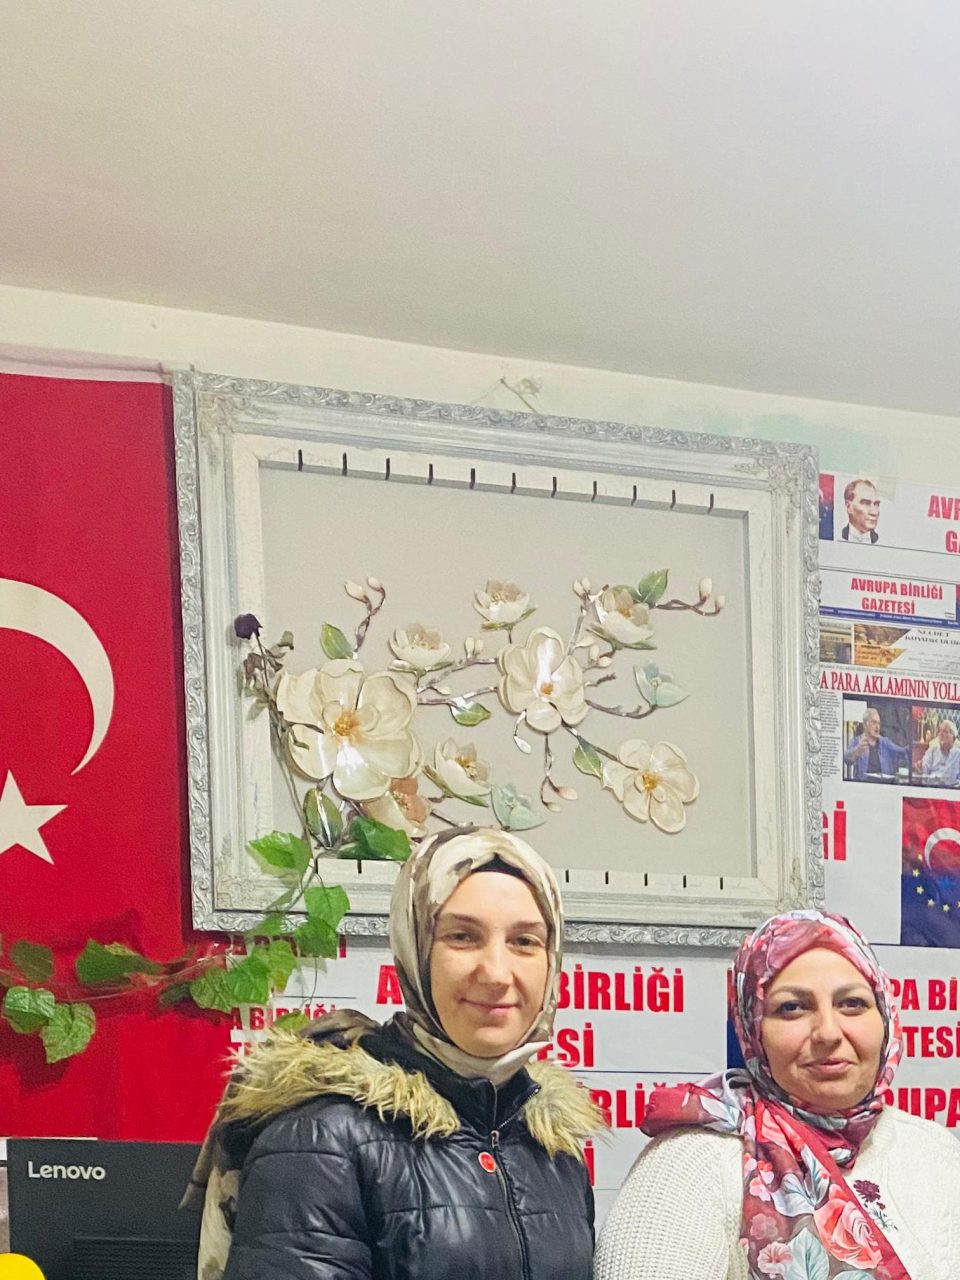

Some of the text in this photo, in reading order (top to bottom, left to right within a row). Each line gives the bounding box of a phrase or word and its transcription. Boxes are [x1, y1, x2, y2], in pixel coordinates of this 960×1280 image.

[850, 577, 943, 601] AVRUPA BİRLİĞİ
[861, 597, 916, 615] GAZETESİ
[831, 671, 861, 693] PARA
[864, 674, 930, 699] AKLAMININ
[27, 1160, 106, 1180] Lenovo
